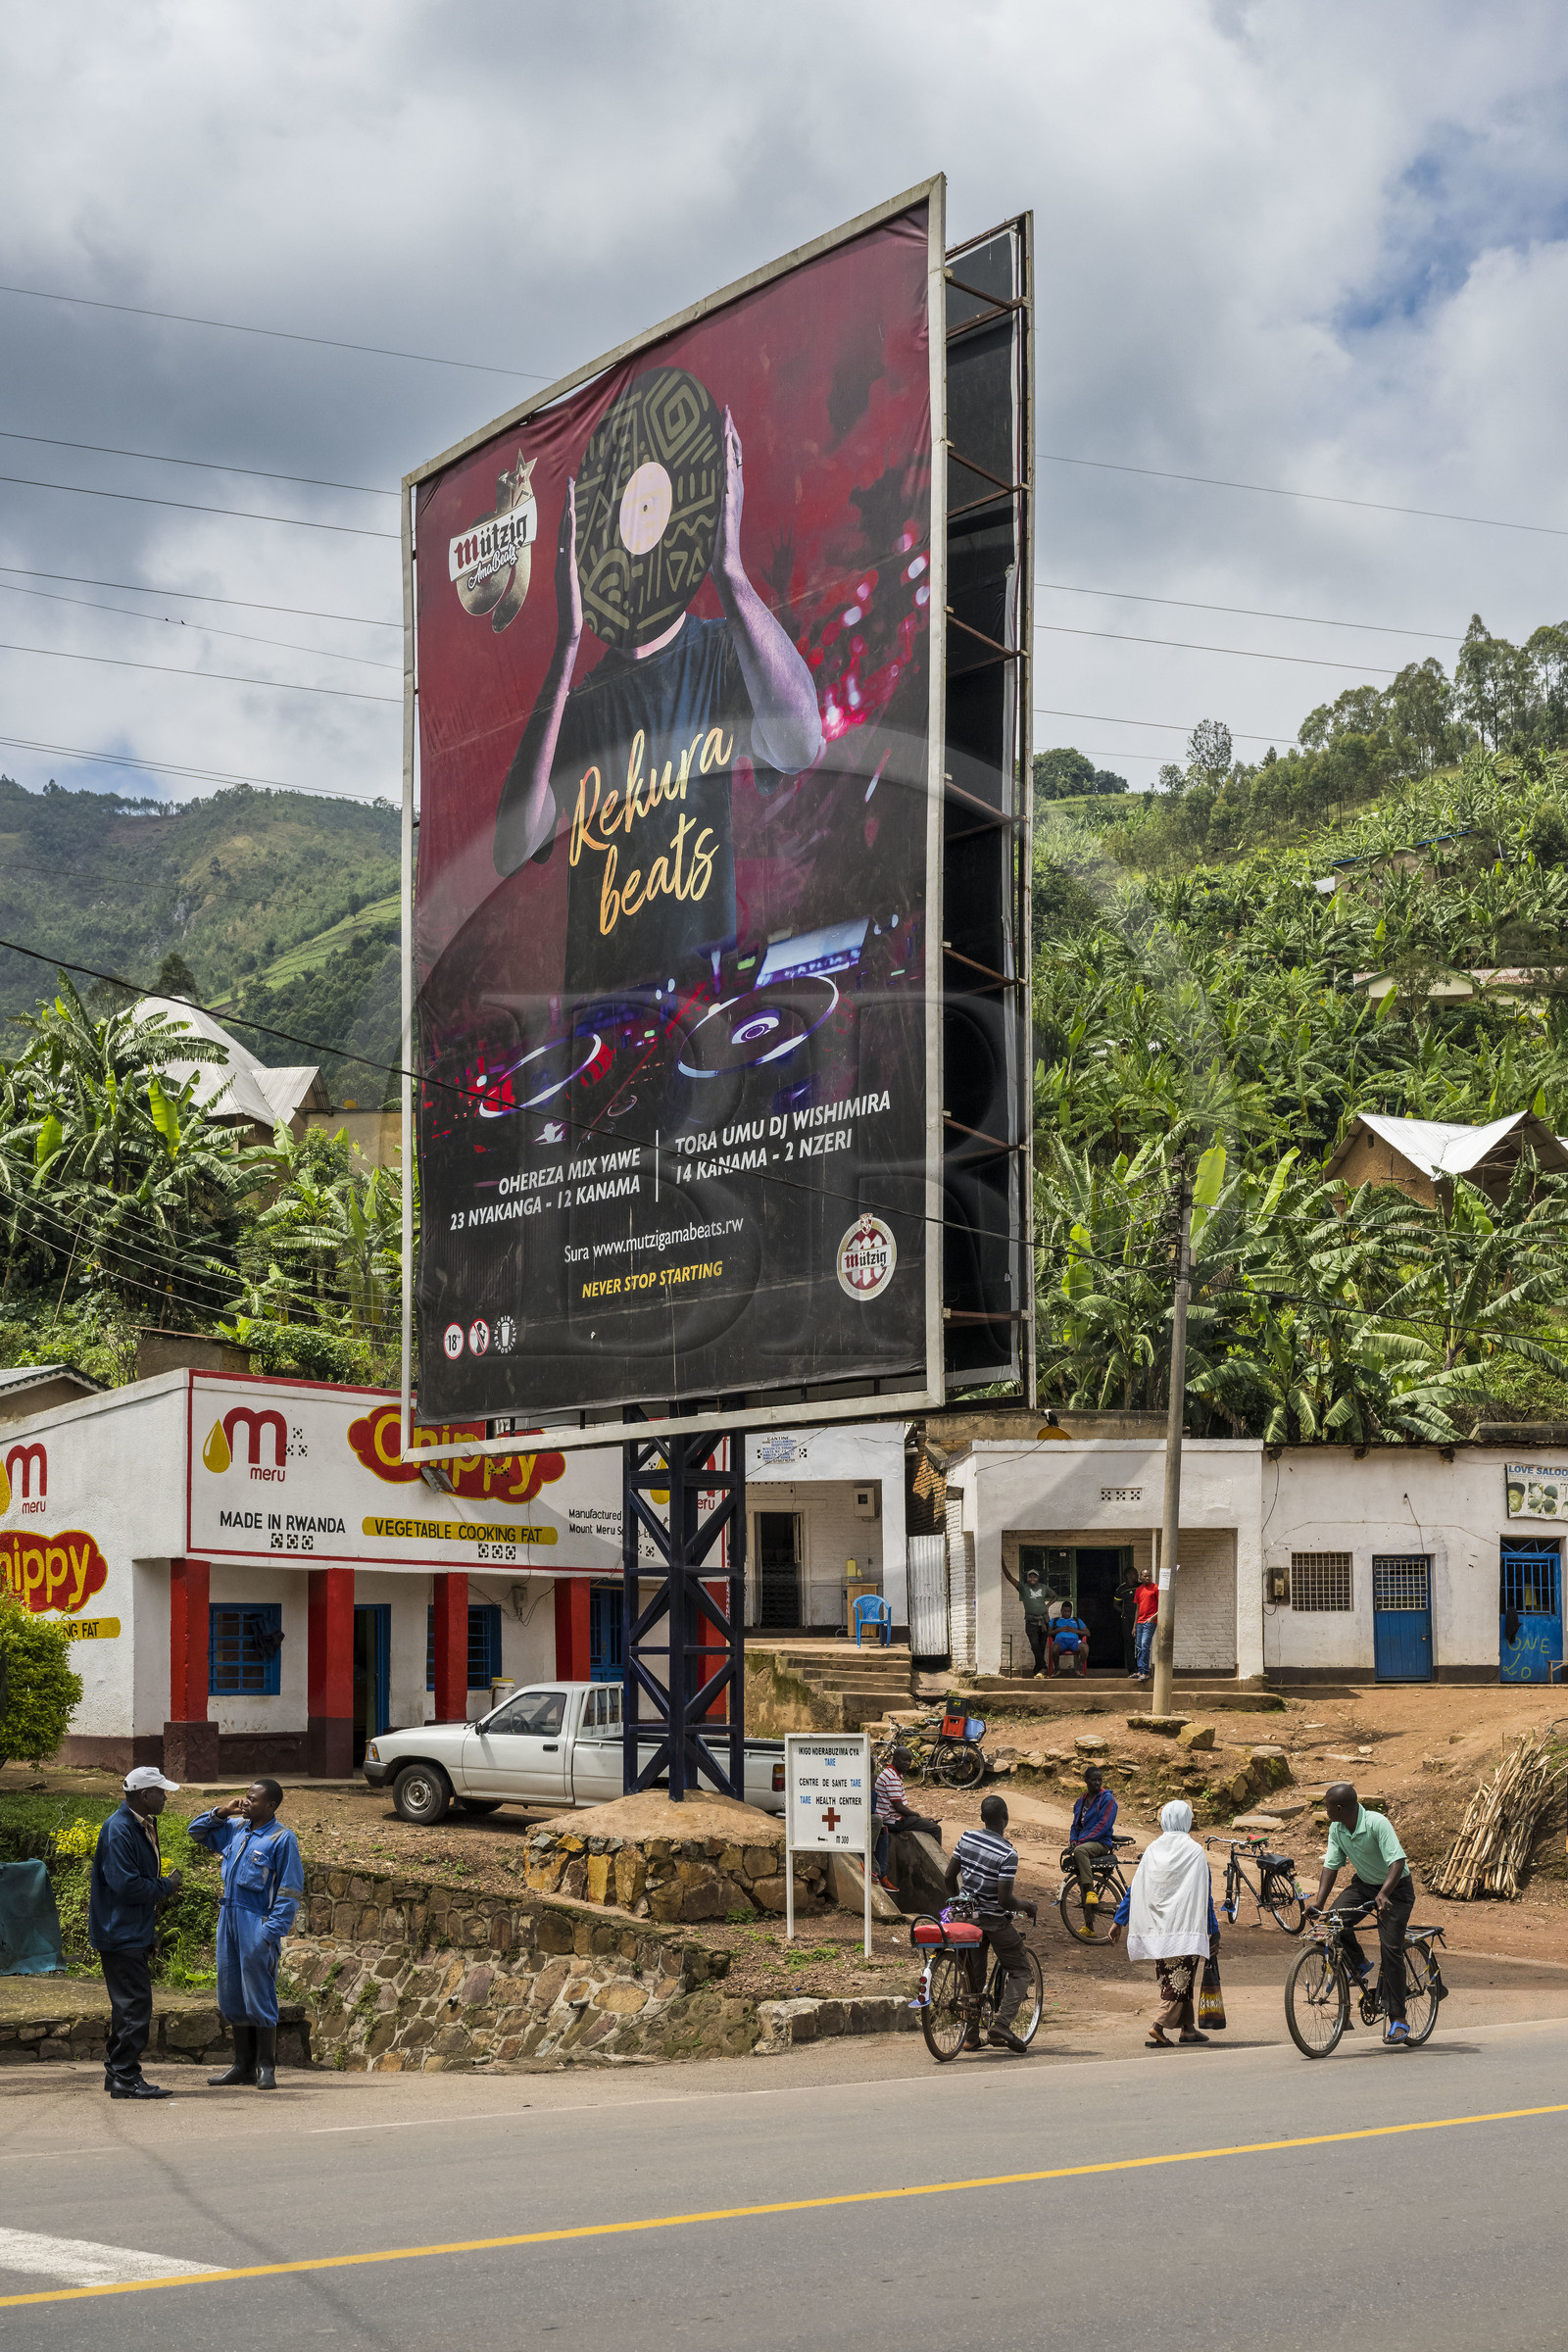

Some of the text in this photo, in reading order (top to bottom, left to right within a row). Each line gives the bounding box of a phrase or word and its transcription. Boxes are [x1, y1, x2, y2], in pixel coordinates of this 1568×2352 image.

[454, 514, 528, 570] Mützig
[569, 726, 734, 867] Rekura
[600, 812, 719, 936] beats
[675, 1090, 891, 1156] TORA UMU DJ WISHIMIRA
[676, 1163, 692, 1184] 14
[696, 1147, 767, 1180] KANAMA
[785, 1143, 794, 1161] 2
[800, 1128, 853, 1158] NZERI
[498, 1148, 641, 1195] OHEREZA MIX YAWE
[450, 1211, 465, 1230] 23
[468, 1196, 542, 1227] NYAKANGA
[558, 1189, 571, 1209] 12
[576, 1175, 640, 1204] KANAMA
[564, 1217, 744, 1263] Sura www.mutzigamabeats.rw
[844, 1250, 887, 1269] Mützig
[582, 1260, 723, 1298] NEVER STOP STARTING
[250, 1467, 286, 1483] meru
[1509, 1465, 1534, 1475] LOVE
[23, 1500, 46, 1515] meru
[697, 1497, 715, 1510] eru
[220, 1511, 346, 1534] MADE IN RWANDA
[568, 1508, 622, 1521] Manufactured
[375, 1519, 543, 1544] VEGETABLE COOKING FAT
[568, 1525, 593, 1535] Mount
[596, 1525, 615, 1536] Meru
[82, 1622, 99, 1639] FAT
[799, 1746, 812, 1755] IKIGO
[824, 1758, 836, 1767] TARE
[799, 1778, 818, 1787] CENTRE
[832, 1779, 848, 1788] SANTE
[851, 1779, 861, 1788] TARE
[800, 1795, 811, 1804] TARE
[816, 1796, 836, 1805] HEALTH
